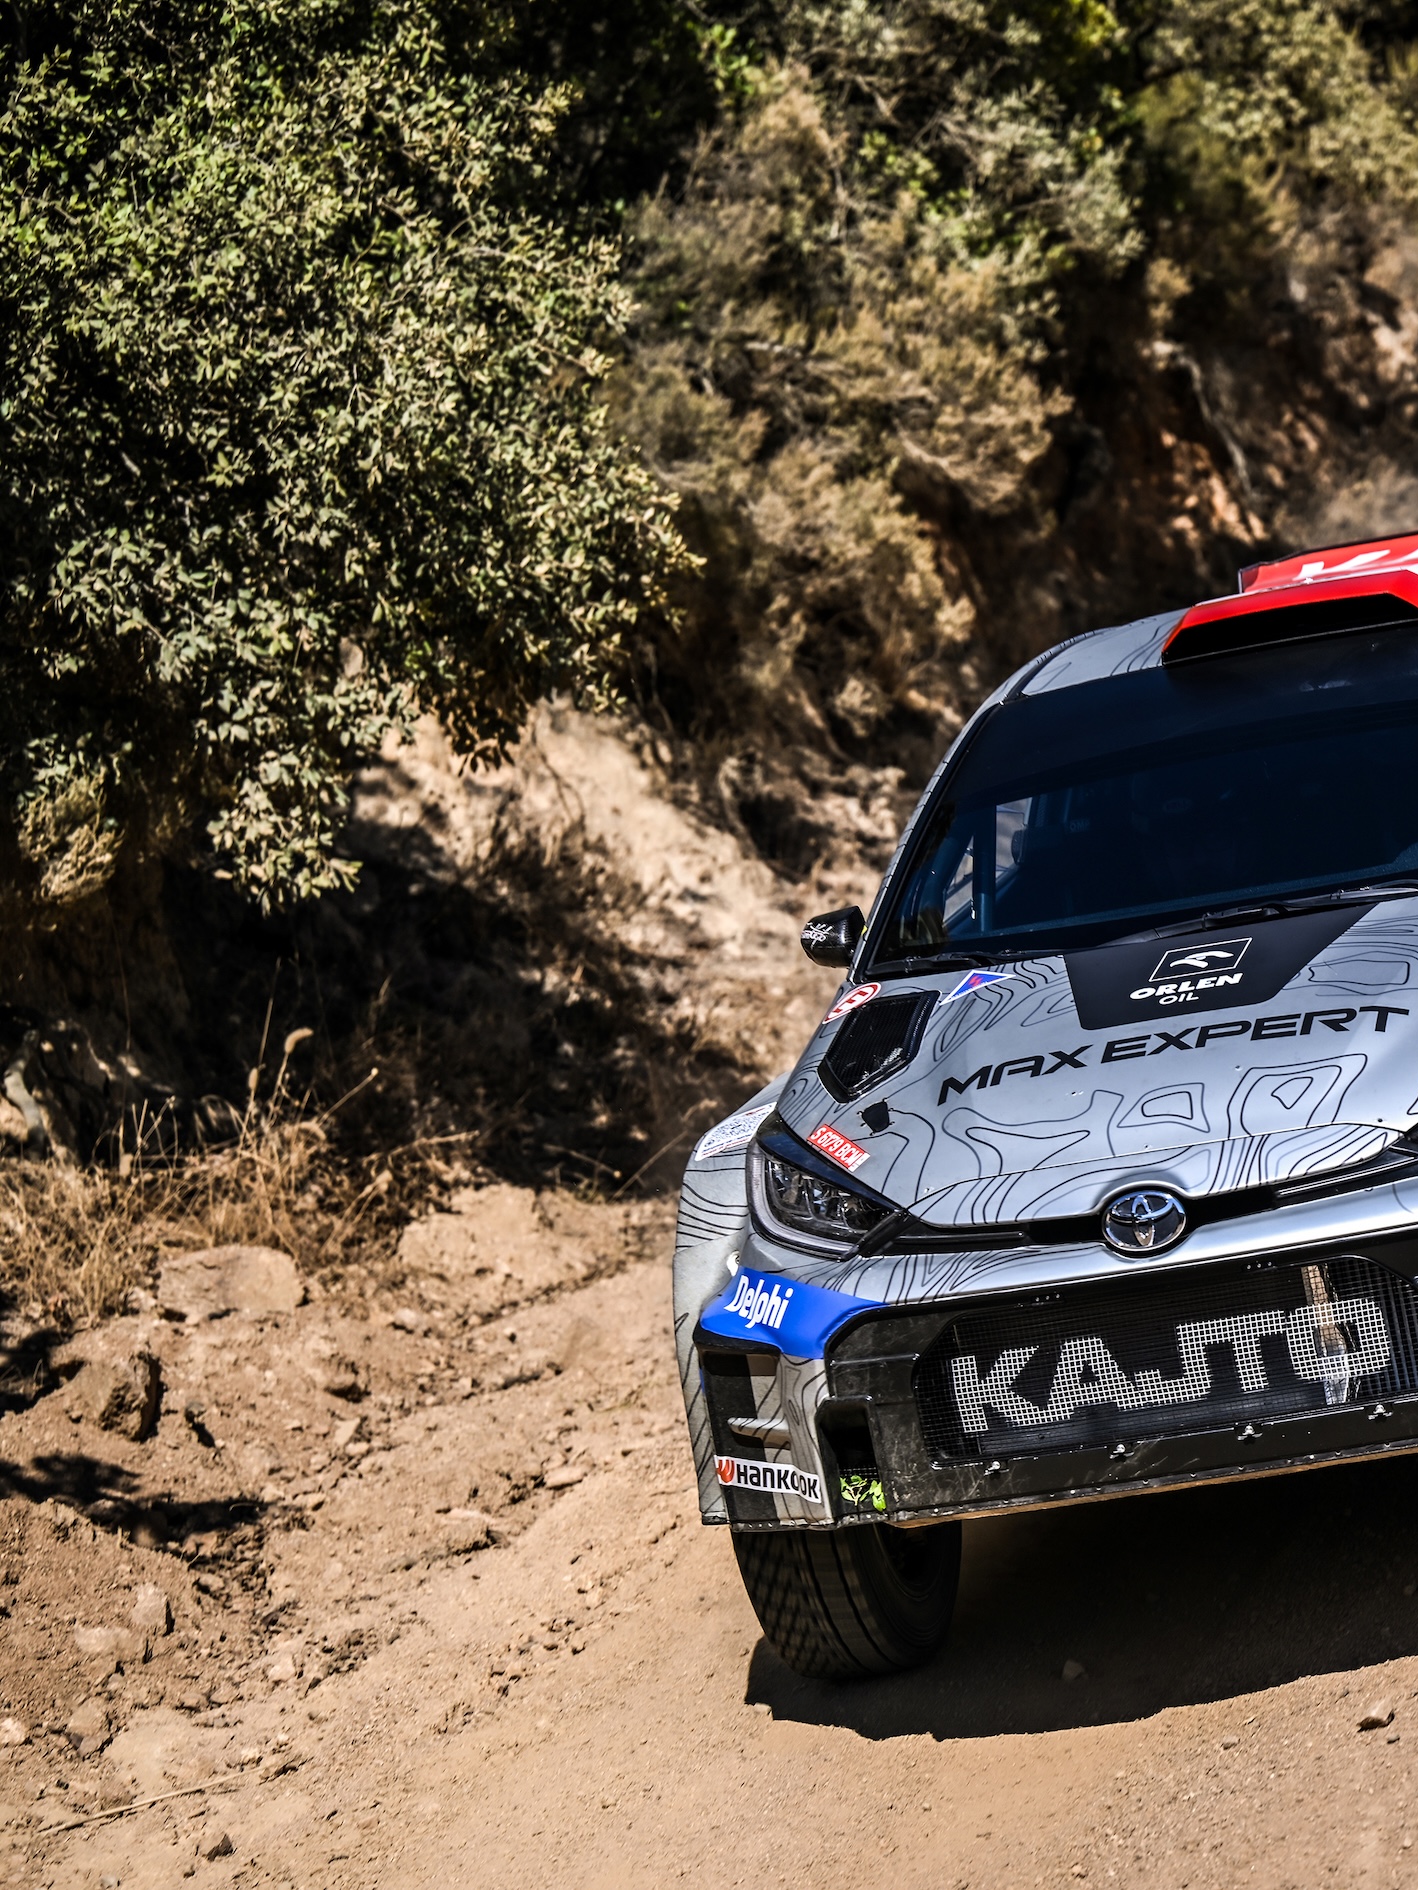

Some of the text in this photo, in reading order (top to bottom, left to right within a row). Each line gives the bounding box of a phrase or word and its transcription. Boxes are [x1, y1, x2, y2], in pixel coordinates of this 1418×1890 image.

[1129, 972, 1243, 1000] ORLEN
[1158, 992, 1200, 1005] OIL
[938, 1006, 1409, 1107] MAX EXPERT
[810, 1127, 827, 1140] S
[723, 1275, 794, 1329] Delphi
[951, 1298, 1392, 1433] KAJTO
